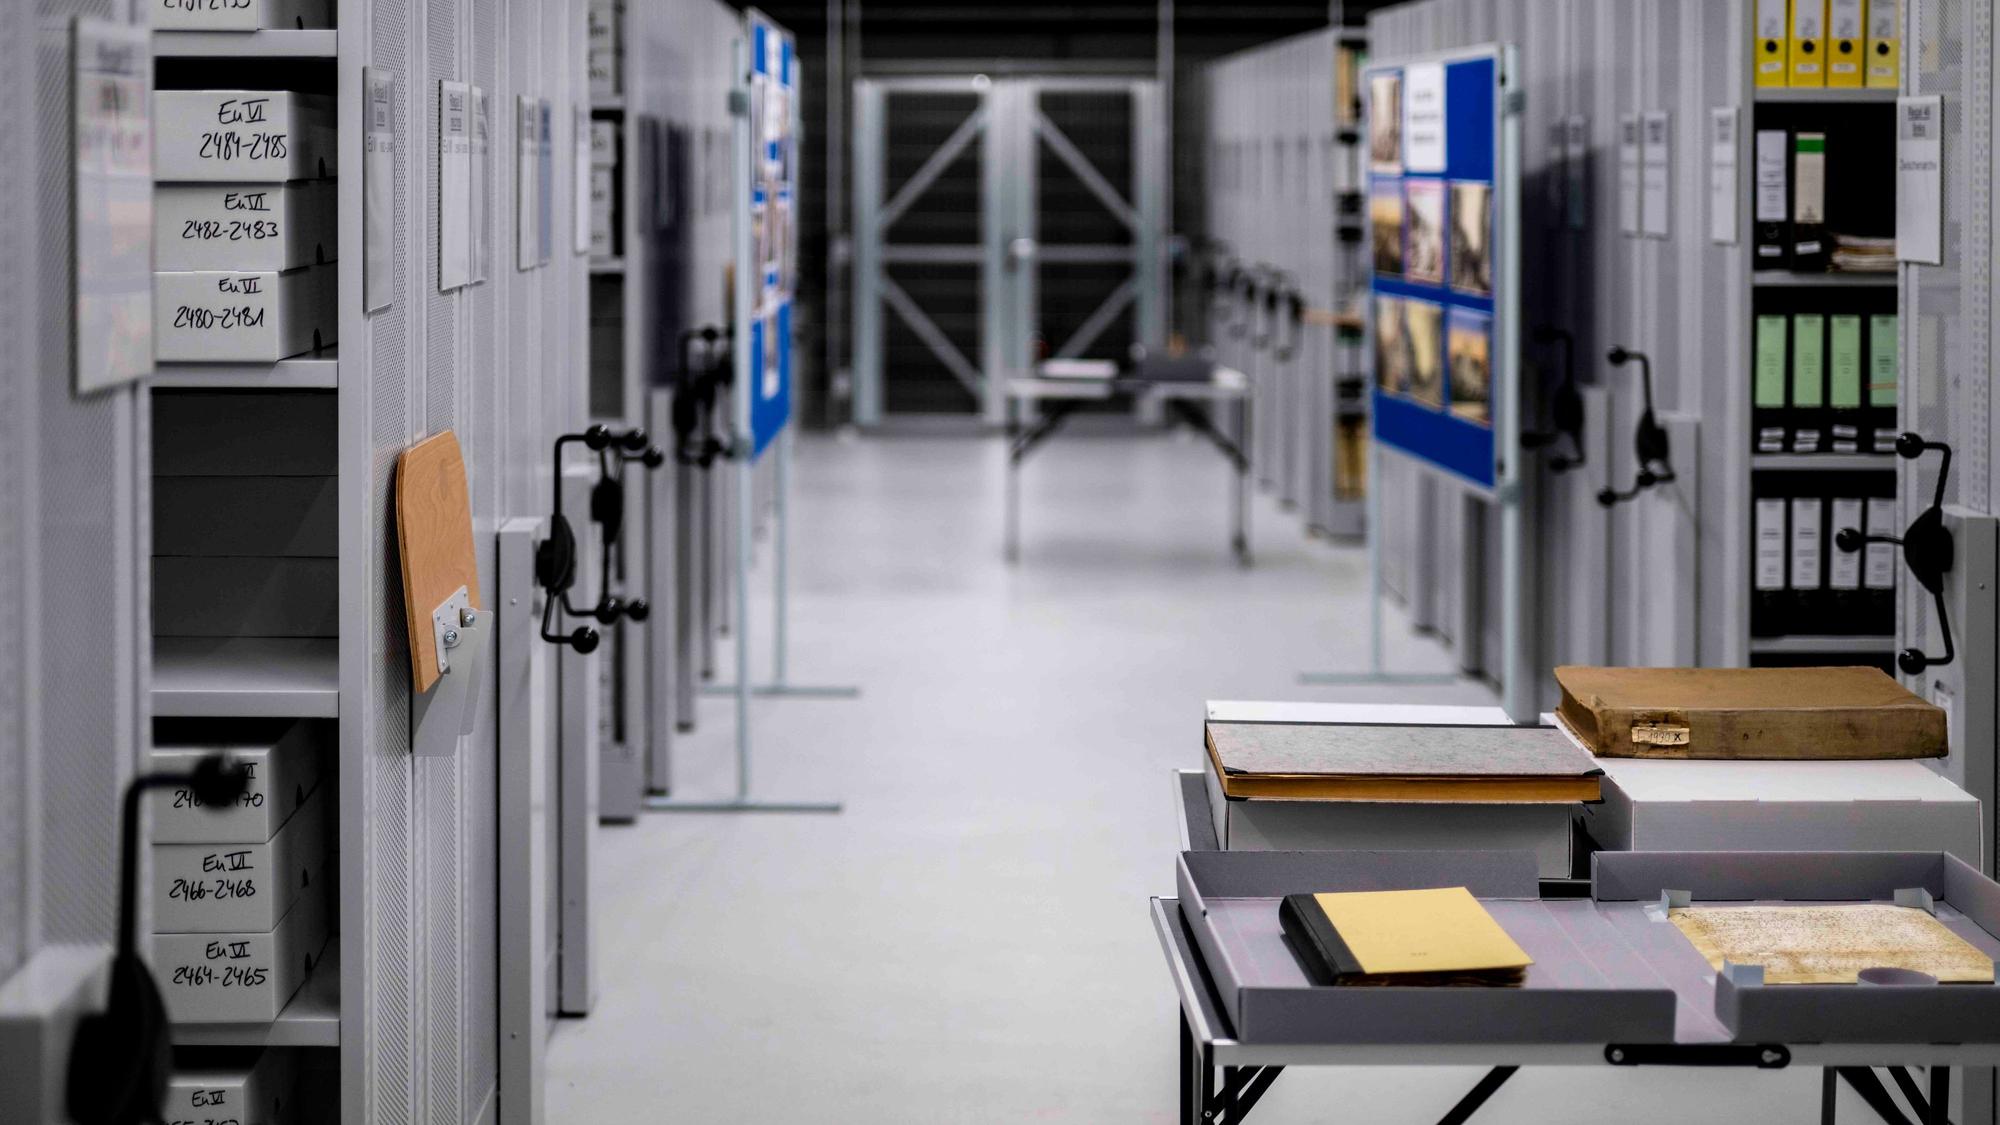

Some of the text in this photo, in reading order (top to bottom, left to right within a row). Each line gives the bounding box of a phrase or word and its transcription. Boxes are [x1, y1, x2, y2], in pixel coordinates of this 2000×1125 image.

[241, 98, 269, 123] VI
[199, 131, 287, 160] 2484-2485
[243, 192, 271, 211] VI
[181, 220, 279, 240] 2482-2483
[238, 277, 262, 294] VI
[173, 305, 264, 329] 2480-2481
[223, 850, 254, 872] VI
[168, 878, 256, 902] 2466-2468
[227, 941, 251, 959] VI
[172, 965, 269, 987] 2464-2465
[208, 1089, 226, 1106] VI
